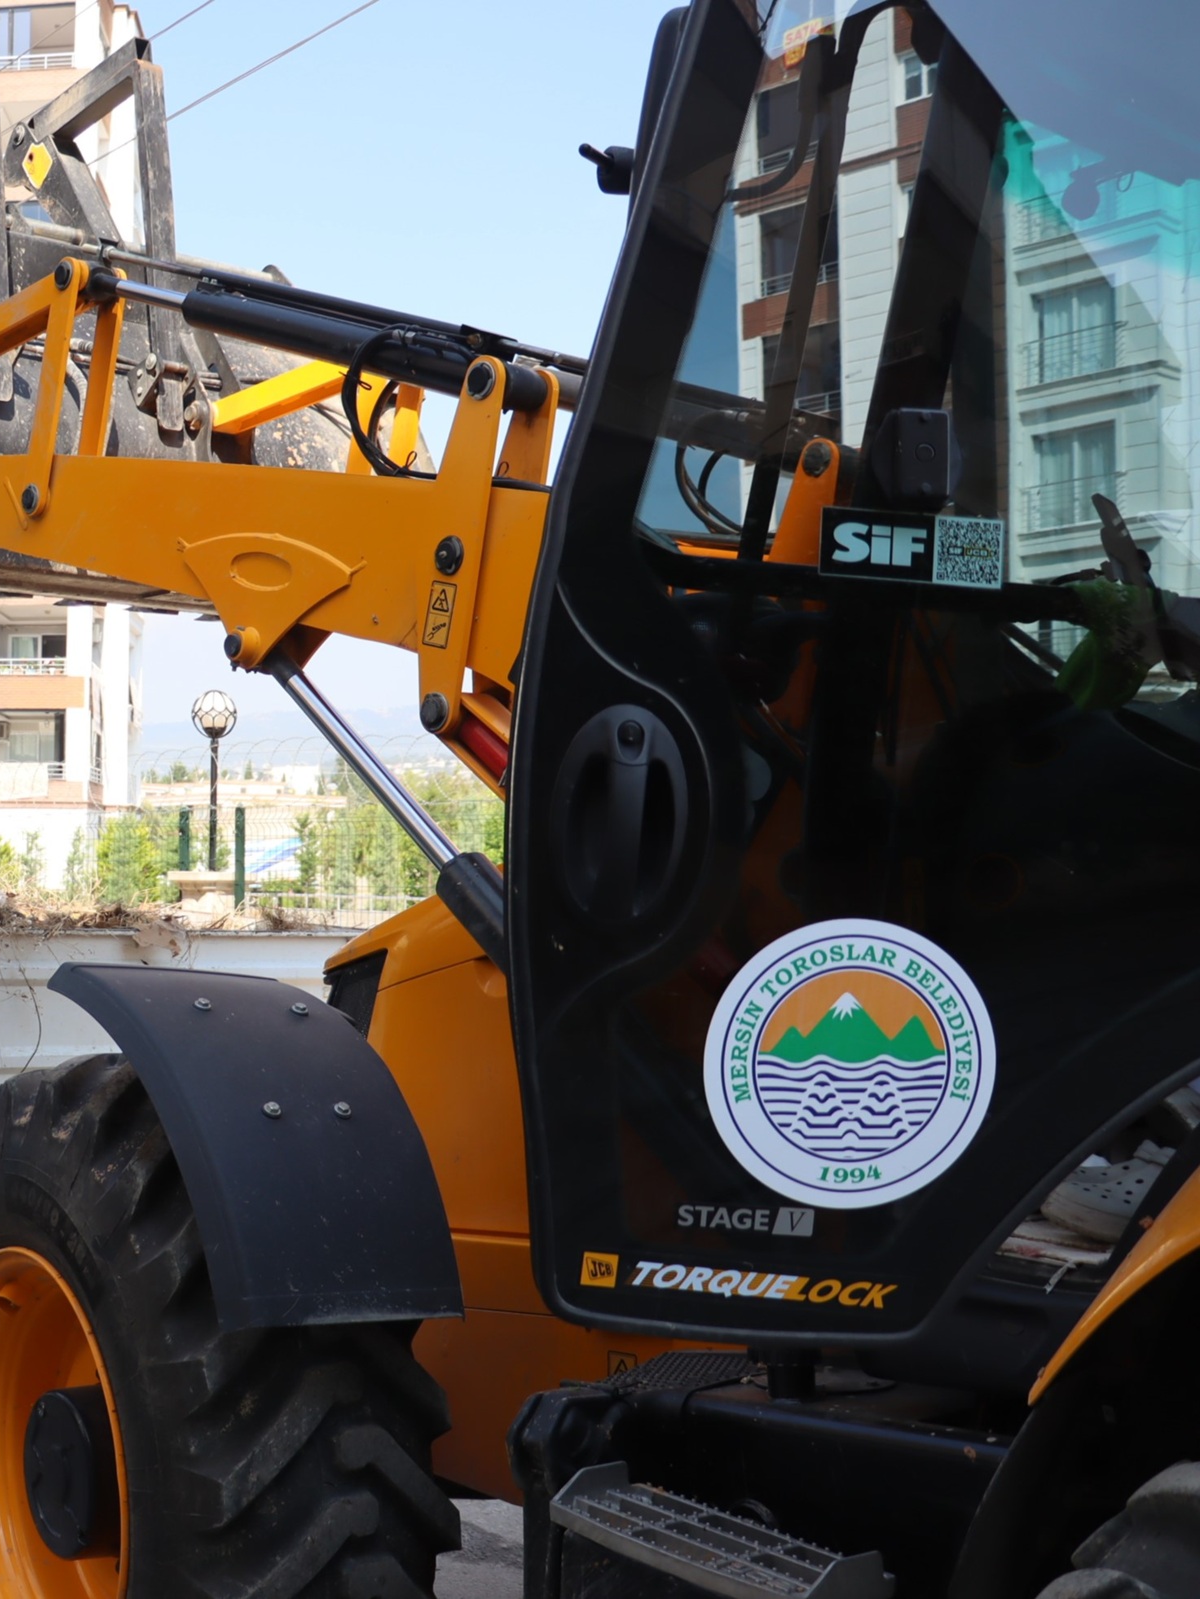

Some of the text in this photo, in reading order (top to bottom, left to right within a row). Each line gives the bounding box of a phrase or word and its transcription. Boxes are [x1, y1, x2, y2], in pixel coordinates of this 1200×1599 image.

[730, 944, 972, 1103] MERSİN TOROSLAR BELEDİYESİ
[817, 1164, 882, 1183] 1994
[677, 1204, 806, 1233] STAGE V
[589, 1258, 614, 1280] JCB
[631, 1260, 898, 1309] TORQUELOCK
